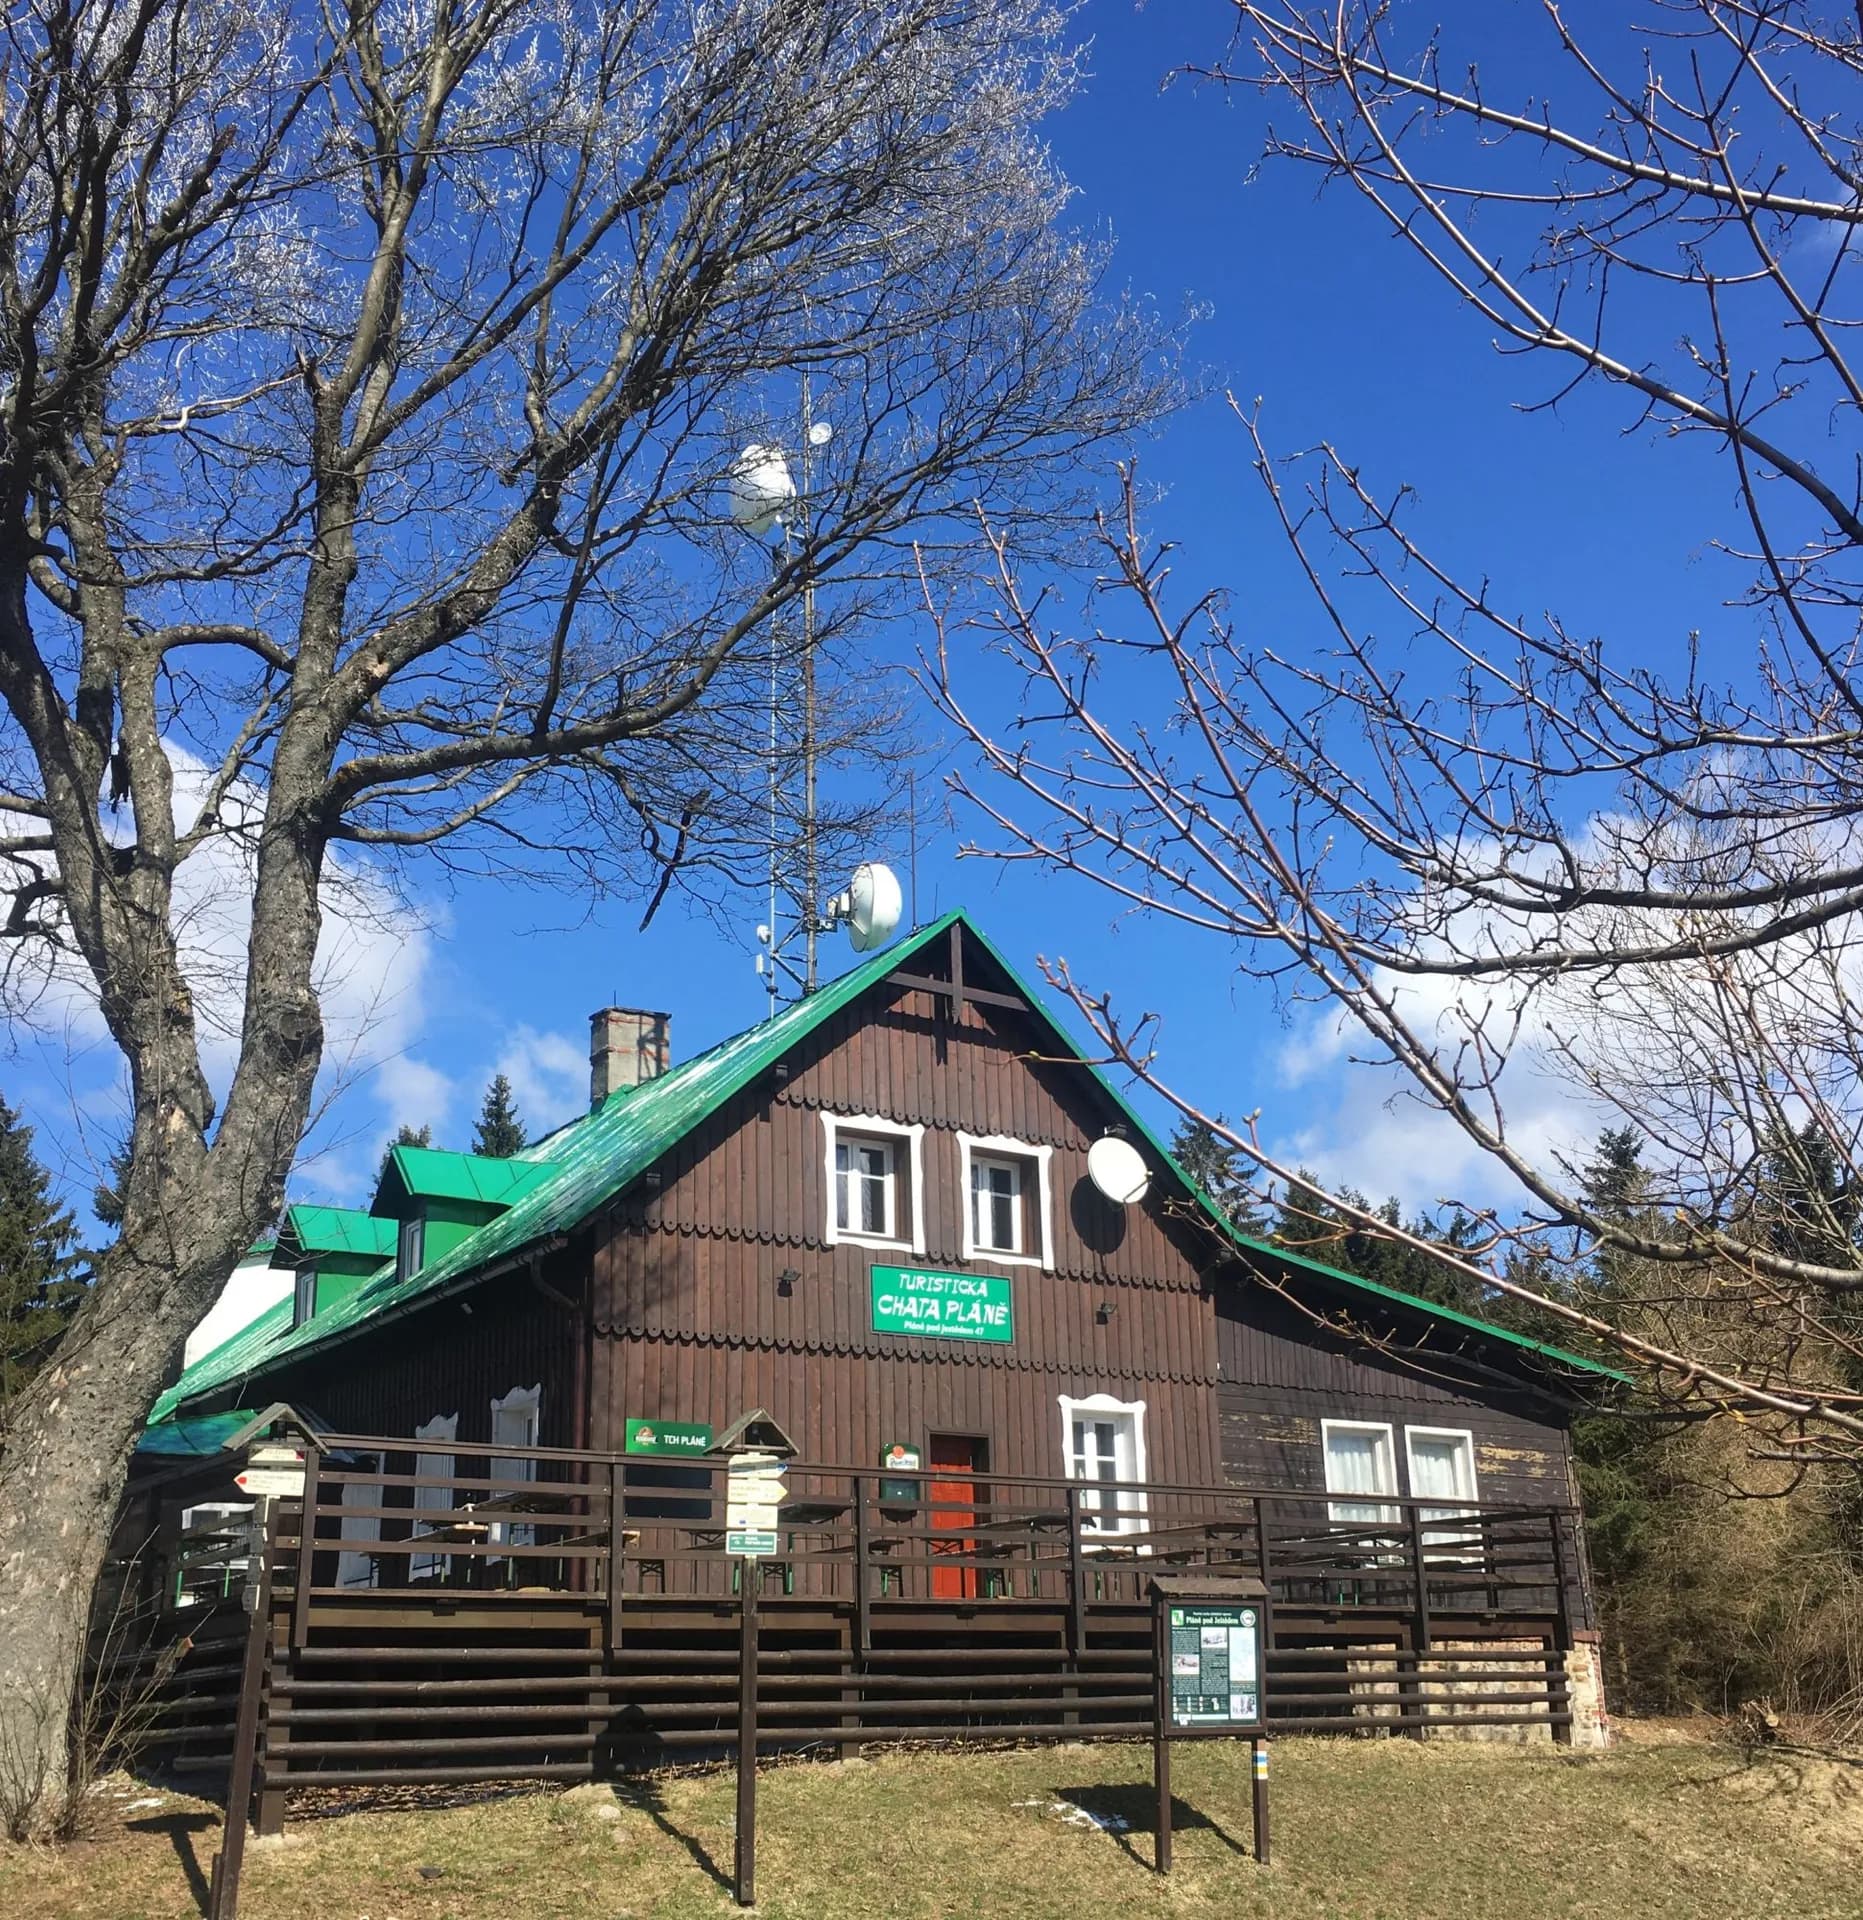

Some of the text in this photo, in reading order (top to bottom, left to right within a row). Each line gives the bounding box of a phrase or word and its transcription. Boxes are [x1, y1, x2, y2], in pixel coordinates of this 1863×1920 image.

[899, 1273, 988, 1297] TURISTICKÁ
[878, 1294, 1009, 1325] CHATA PLÁNĚ
[663, 1434, 679, 1444] TCH
